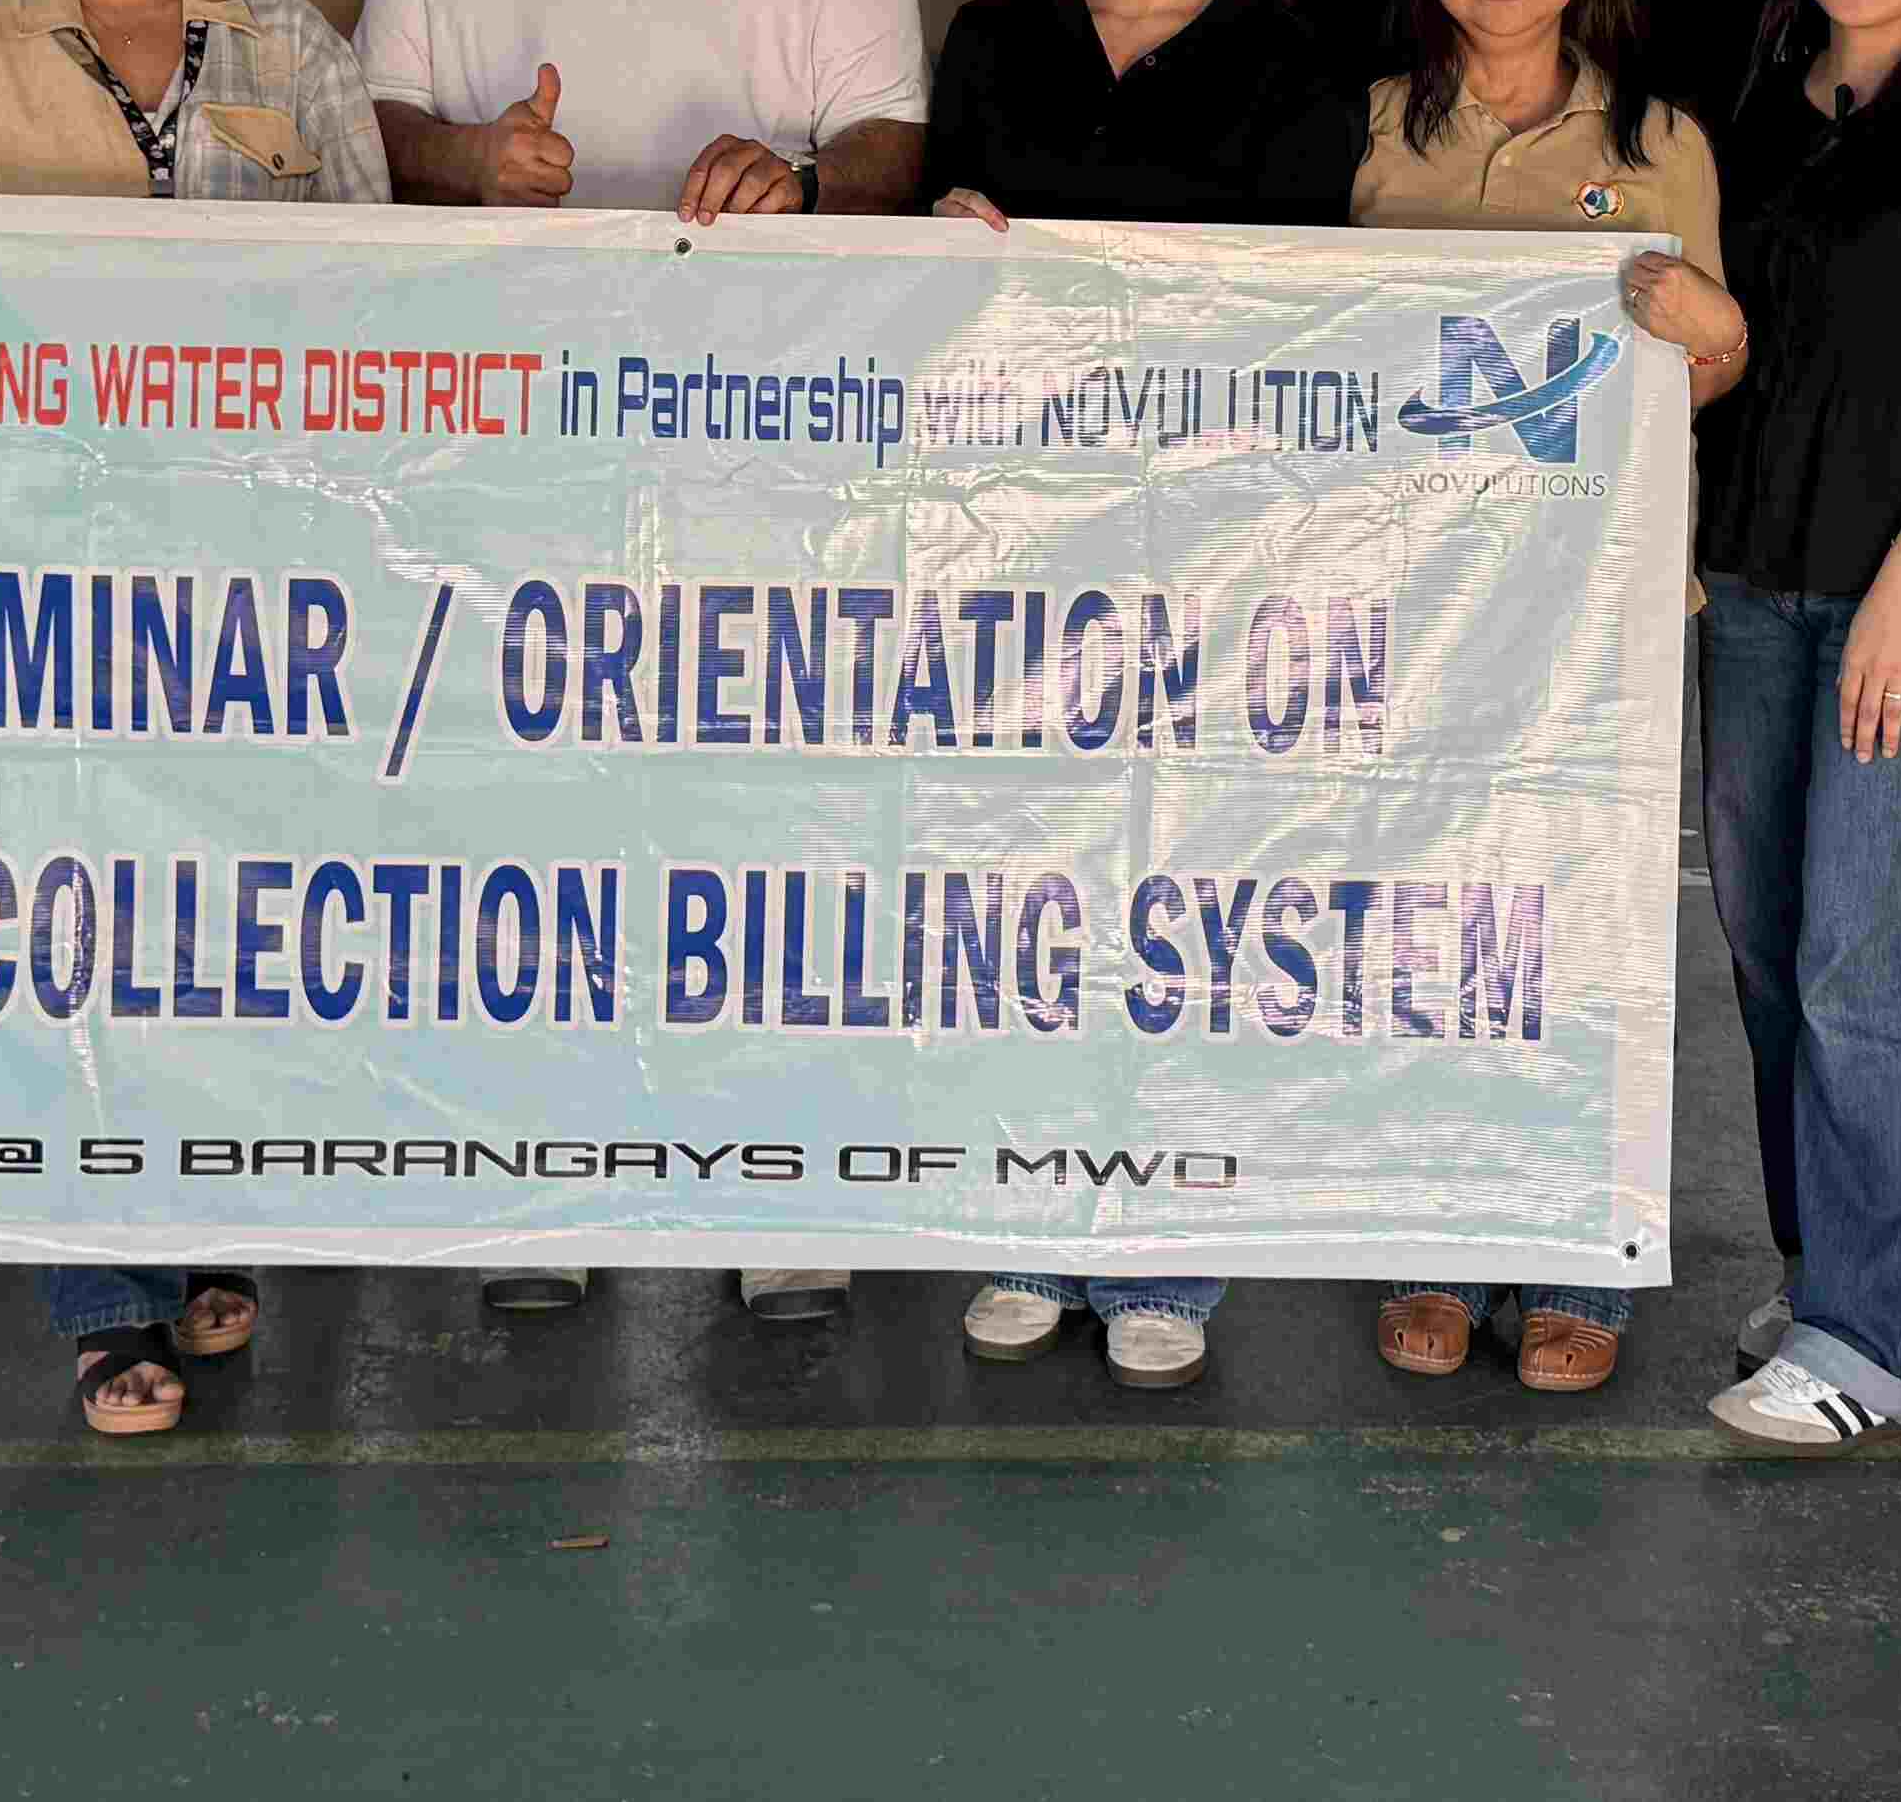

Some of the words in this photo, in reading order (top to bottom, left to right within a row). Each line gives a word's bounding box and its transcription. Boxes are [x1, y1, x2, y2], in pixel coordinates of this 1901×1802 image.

[89, 343, 283, 432] WATER
[302, 348, 543, 437] DISTRICT
[561, 349, 599, 438] in
[617, 352, 905, 469] Partnership
[384, 580, 454, 777] /
[501, 579, 1201, 752] ORIENTATION
[1244, 592, 1386, 755] ON
[664, 868, 1085, 1033] BILLING
[1124, 873, 1546, 1041] SYSTEM
[78, 1138, 145, 1176] 5
[179, 1138, 804, 1181] BARANGAYS
[837, 1145, 967, 1184] OF
